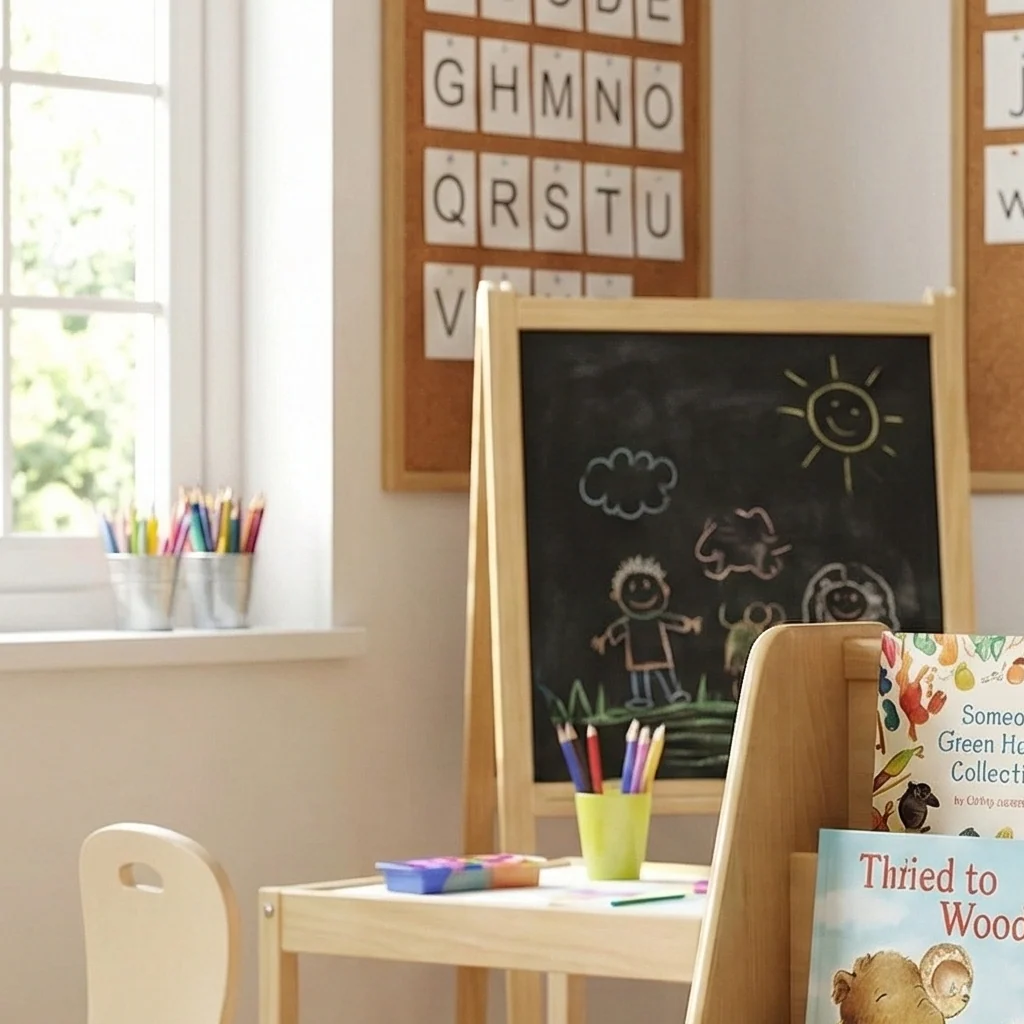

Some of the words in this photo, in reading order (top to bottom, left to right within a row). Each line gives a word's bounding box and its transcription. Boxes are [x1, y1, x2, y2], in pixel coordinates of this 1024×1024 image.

[434, 58, 464, 107] G
[491, 63, 518, 114] H
[541, 70, 573, 119] M
[596, 78, 622, 126] N
[643, 83, 673, 130] O
[433, 173, 465, 227] Q
[491, 179, 519, 228] R
[544, 183, 570, 231] S
[596, 187, 621, 235] T
[645, 191, 671, 239] U
[434, 287, 465, 338] V
[938, 731, 994, 754] Green
[965, 863, 998, 896] to
